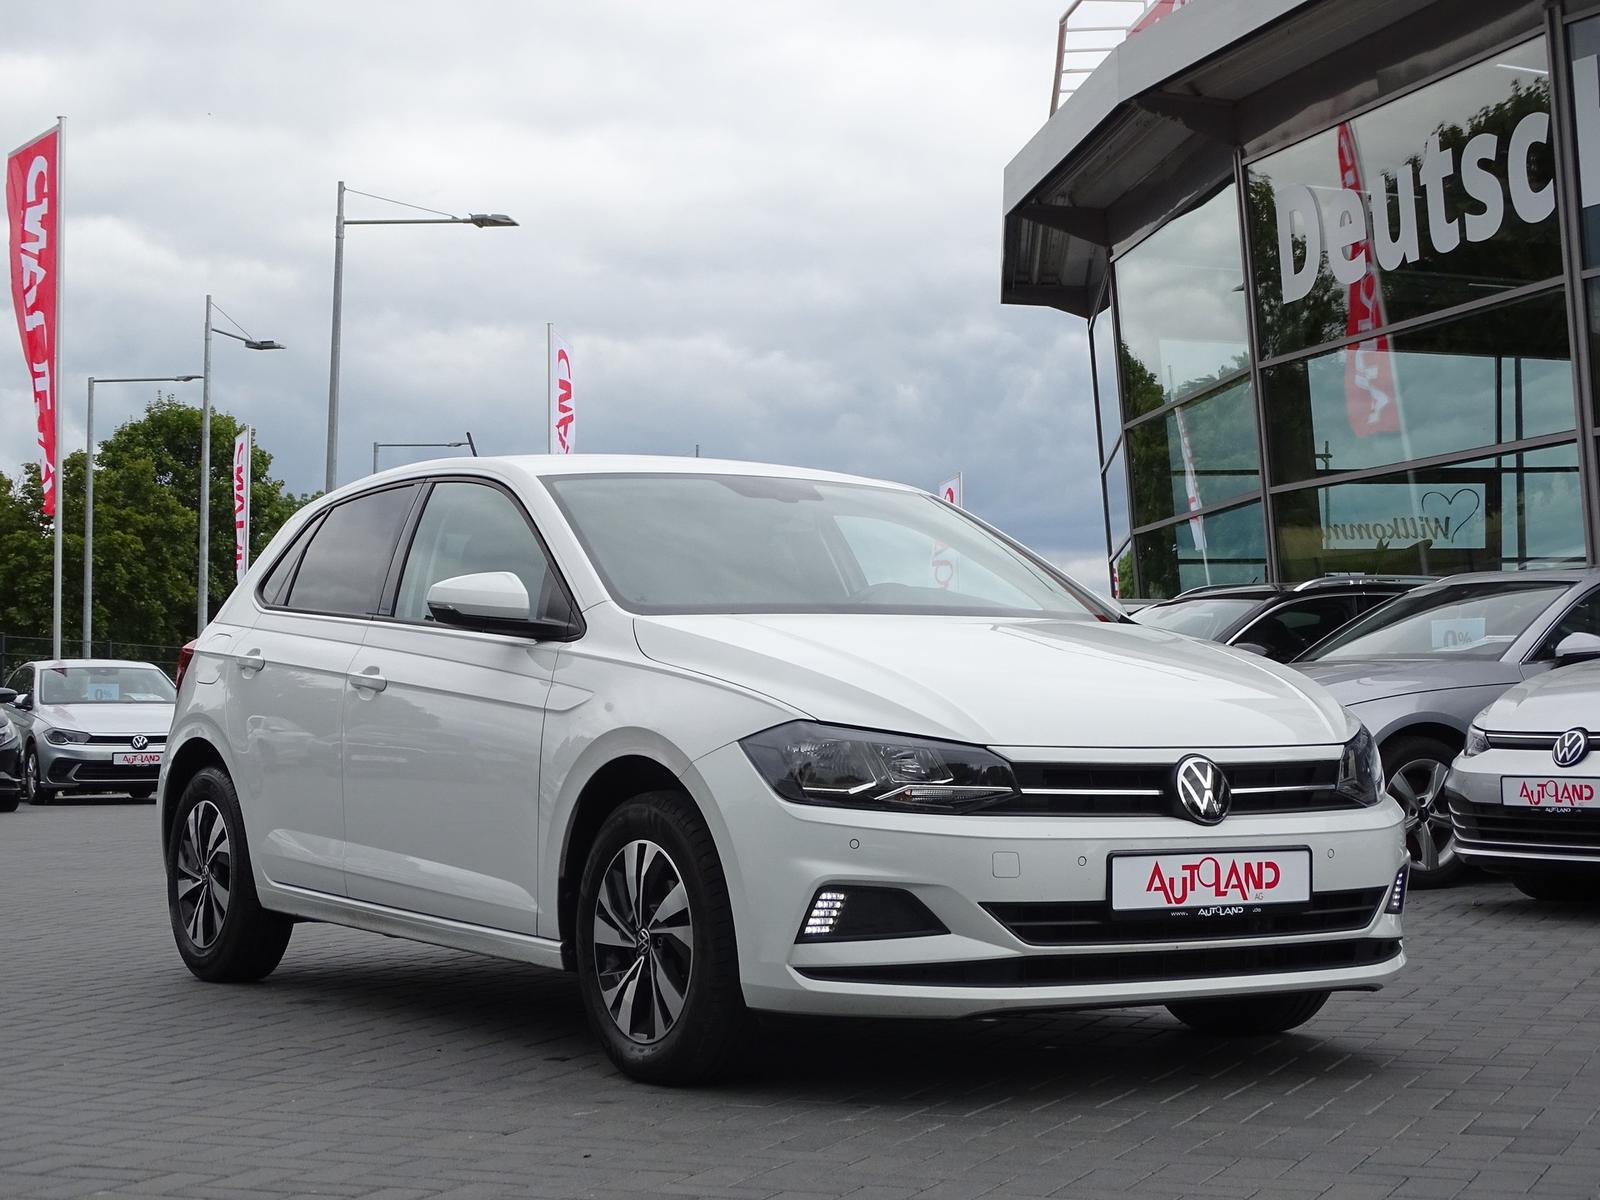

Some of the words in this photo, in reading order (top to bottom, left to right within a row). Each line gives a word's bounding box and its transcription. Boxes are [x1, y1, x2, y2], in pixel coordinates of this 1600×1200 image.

[1443, 630, 1472, 647] 0%
[1519, 779, 1594, 807] AUTOLAND
[1146, 856, 1281, 905] AUTOLAND
[1255, 892, 1264, 901] AG
[1198, 905, 1244, 917] AUTOLAND
